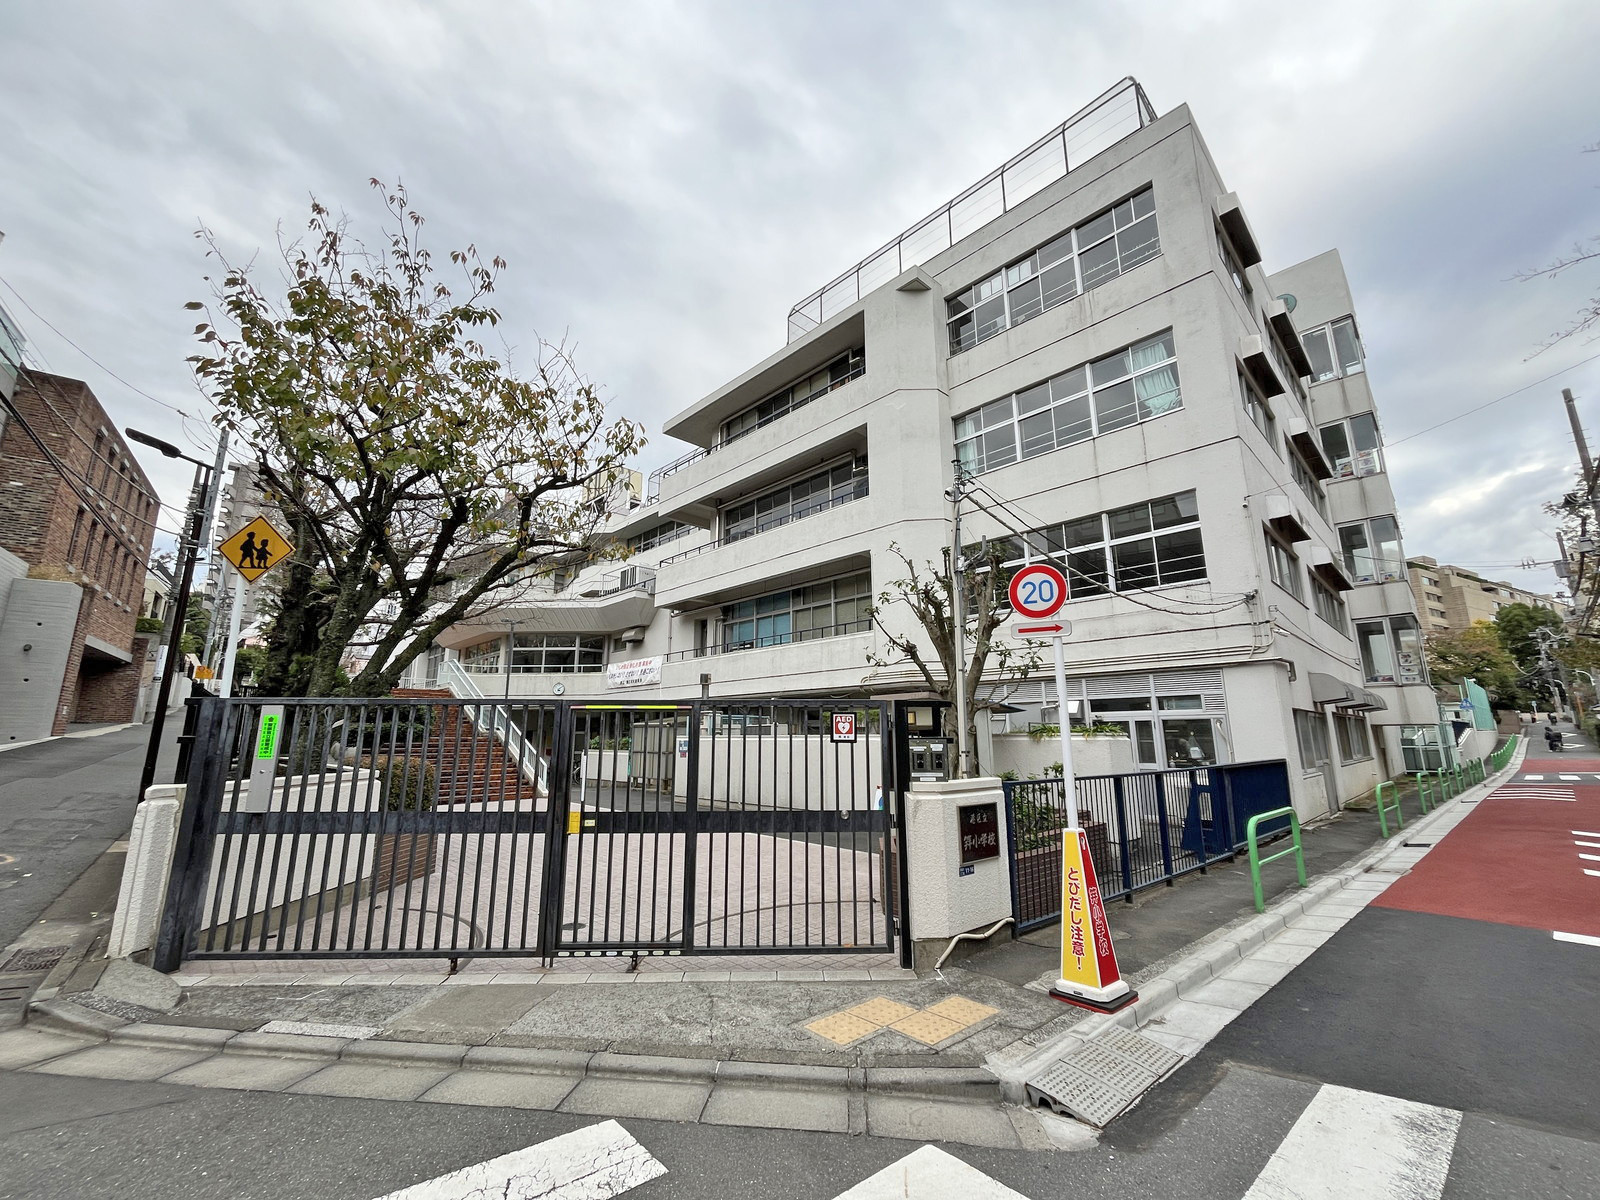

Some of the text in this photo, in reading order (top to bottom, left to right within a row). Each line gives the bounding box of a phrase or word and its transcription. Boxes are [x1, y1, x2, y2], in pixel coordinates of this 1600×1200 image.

[1022, 579, 1054, 604] 20
[1068, 867, 1085, 970] とびだし注意！
